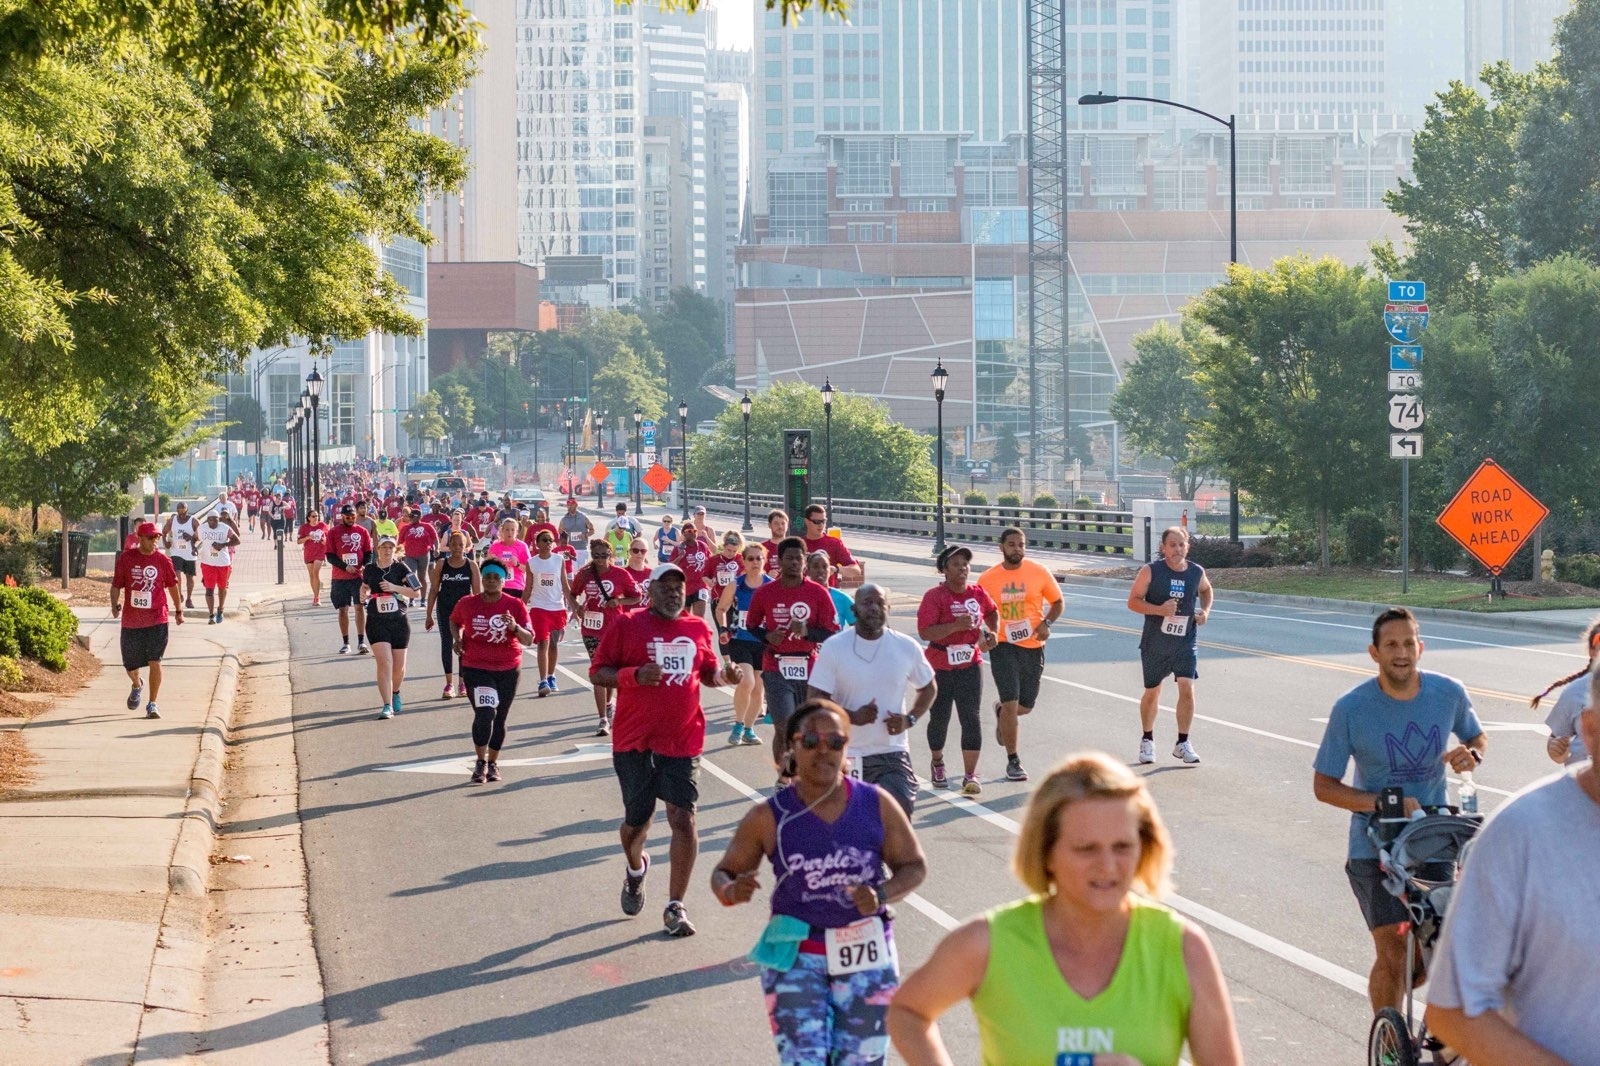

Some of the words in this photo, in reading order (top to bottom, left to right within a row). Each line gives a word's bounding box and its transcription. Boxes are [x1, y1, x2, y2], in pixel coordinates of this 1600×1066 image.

[1398, 285, 1416, 297] TO
[1397, 375, 1415, 387] TO
[1393, 402, 1420, 423] 74
[1471, 488, 1513, 504] ROAD
[1471, 508, 1514, 525] WORK
[1469, 528, 1520, 546] AHEAD
[540, 578, 554, 587] 906
[133, 597, 148, 607] 943
[380, 602, 395, 612] 617
[1001, 602, 1019, 620] 5K
[585, 618, 602, 629] 1116
[1166, 623, 1184, 634] 616
[1010, 628, 1029, 641] 990
[663, 656, 686, 670] 651
[782, 666, 806, 677] 1029
[479, 694, 496, 706] 663
[787, 849, 850, 874] Purple
[839, 940, 879, 968] 976
[1057, 1027, 1114, 1053] RUN
